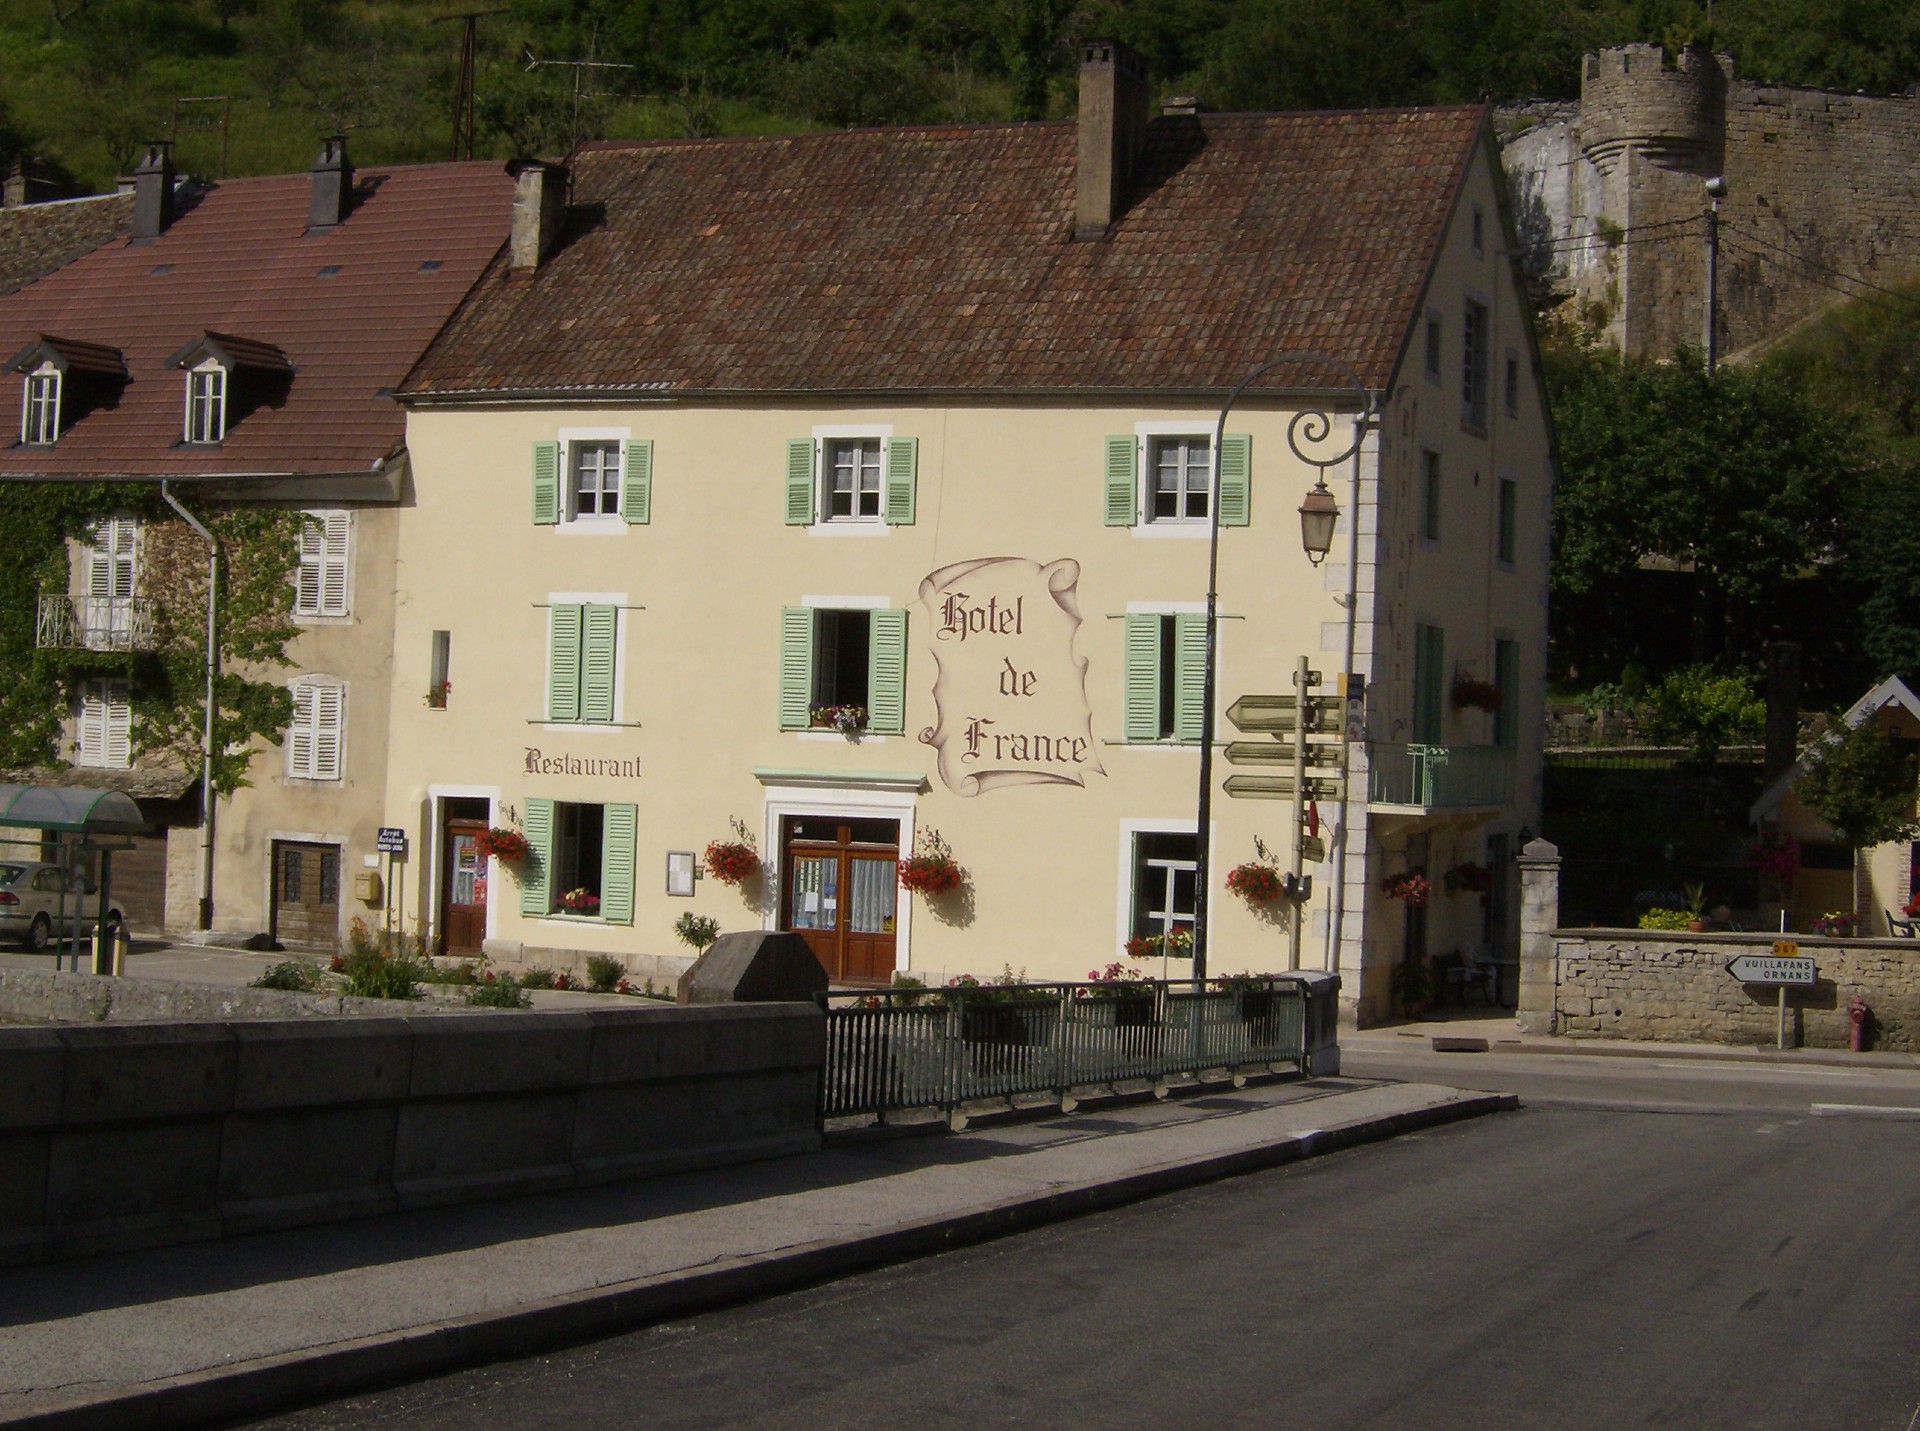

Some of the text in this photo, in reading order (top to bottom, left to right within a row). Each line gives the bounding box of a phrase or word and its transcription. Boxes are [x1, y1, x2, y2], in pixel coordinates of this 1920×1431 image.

[936, 592, 1024, 642] Hotel
[999, 656, 1037, 697] de
[961, 716, 1088, 764] France
[522, 747, 642, 778] Restaurant
[1745, 960, 1811, 970] VUILLAFANS
[1764, 970, 1810, 979] ORNANS
